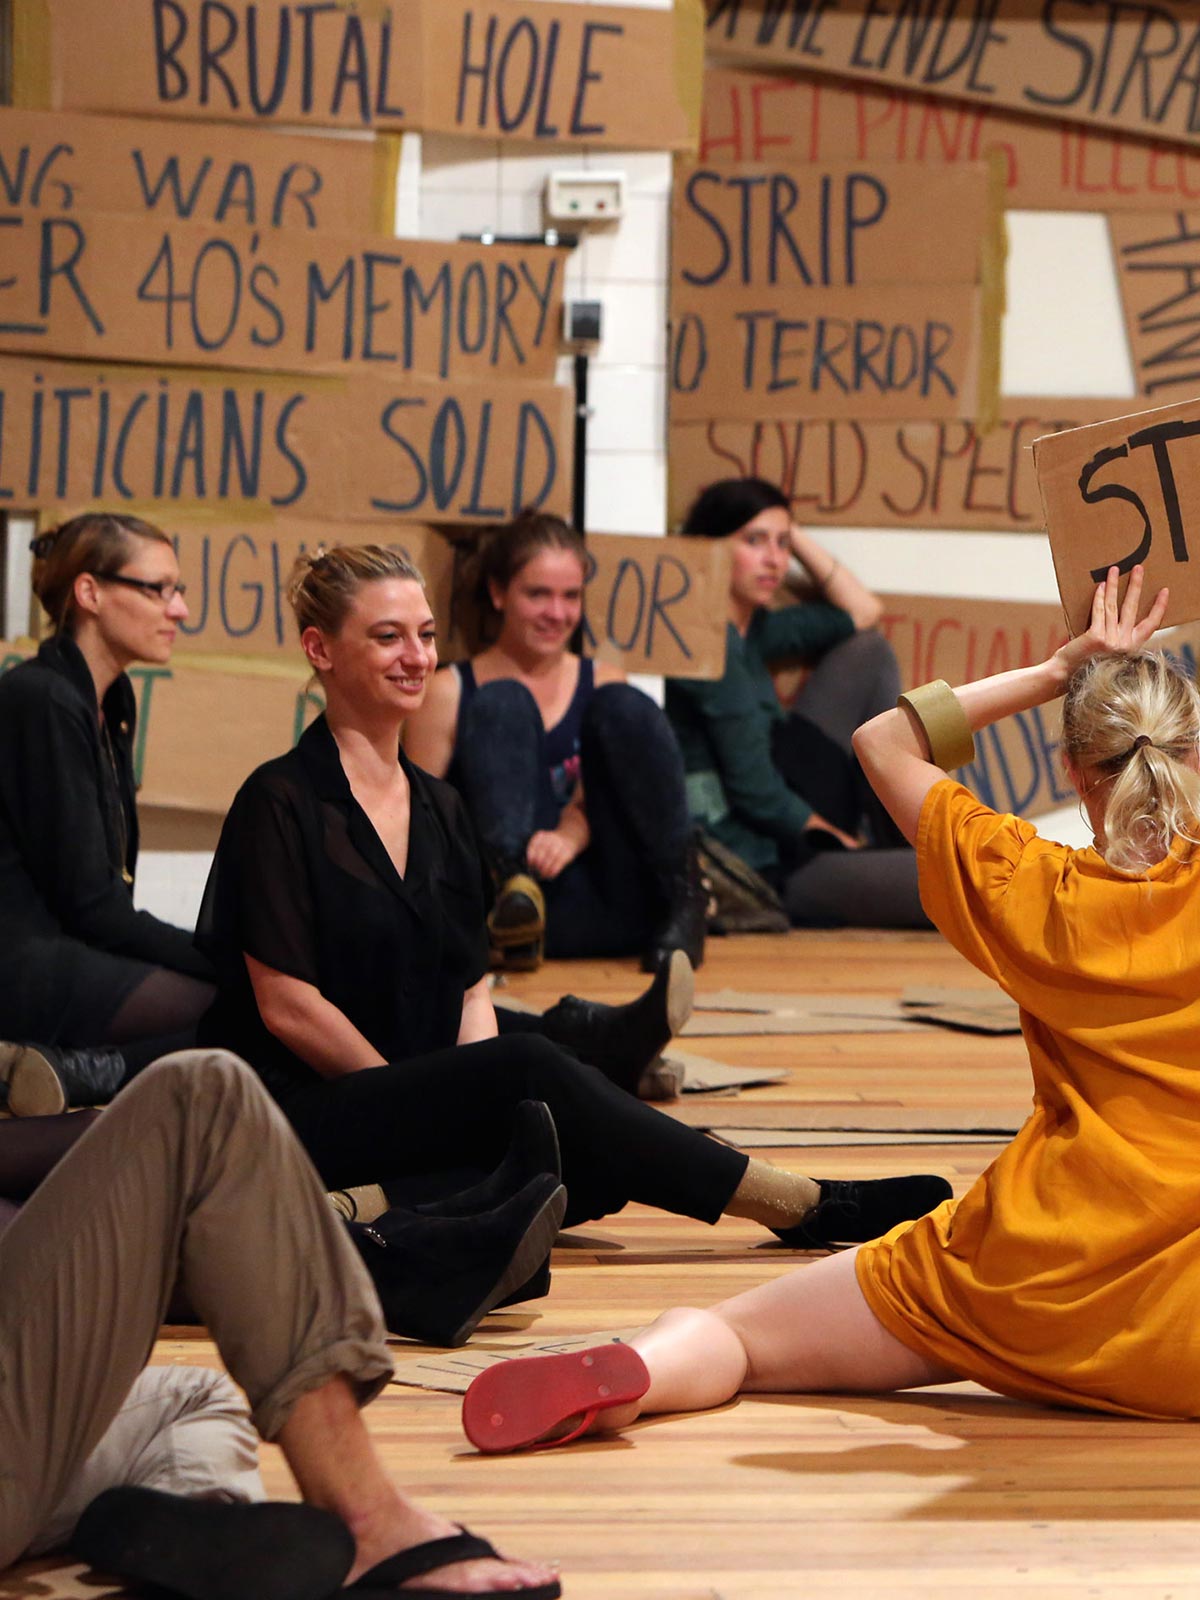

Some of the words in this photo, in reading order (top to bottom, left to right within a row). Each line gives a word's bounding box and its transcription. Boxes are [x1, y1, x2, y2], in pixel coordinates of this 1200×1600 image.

[152, 0, 404, 124] BRUTAL
[455, 11, 624, 138] HOLE
[131, 149, 323, 229] WAR
[681, 169, 889, 286] STRIP
[304, 251, 558, 380] MEMORY
[734, 309, 958, 398] TERROR
[370, 396, 557, 518] SOLD
[881, 416, 1078, 519] SPEC
